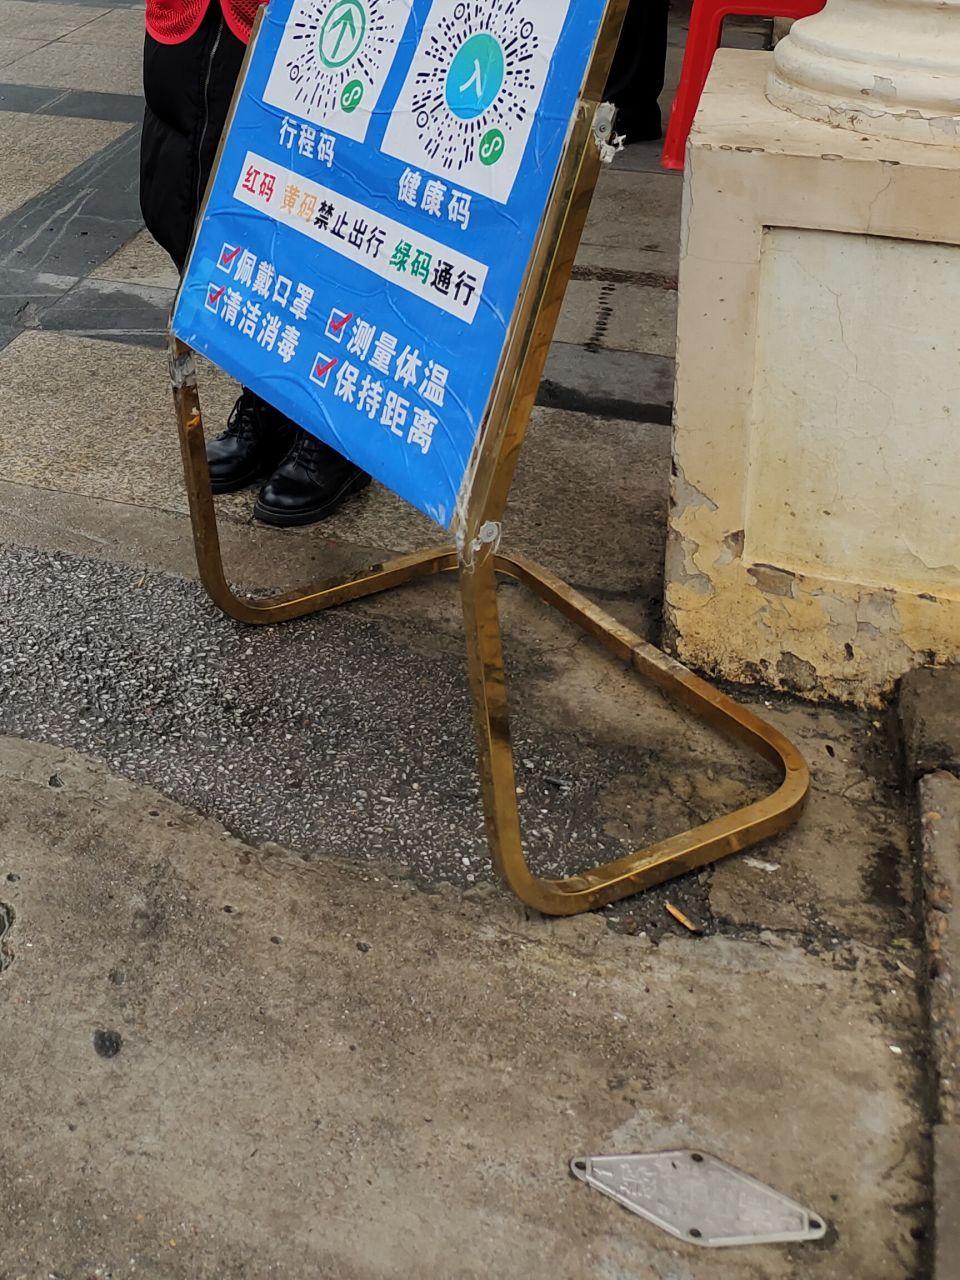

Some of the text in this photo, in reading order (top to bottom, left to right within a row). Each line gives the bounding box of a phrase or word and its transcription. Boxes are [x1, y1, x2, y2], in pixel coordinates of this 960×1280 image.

[279, 116, 336, 168] 行程码
[397, 166, 472, 231] 健康码
[233, 248, 315, 321] 佩戴口罩
[220, 287, 302, 364] 清洁消毒
[346, 317, 449, 408] 测量体温
[333, 360, 438, 455] 保持距离
